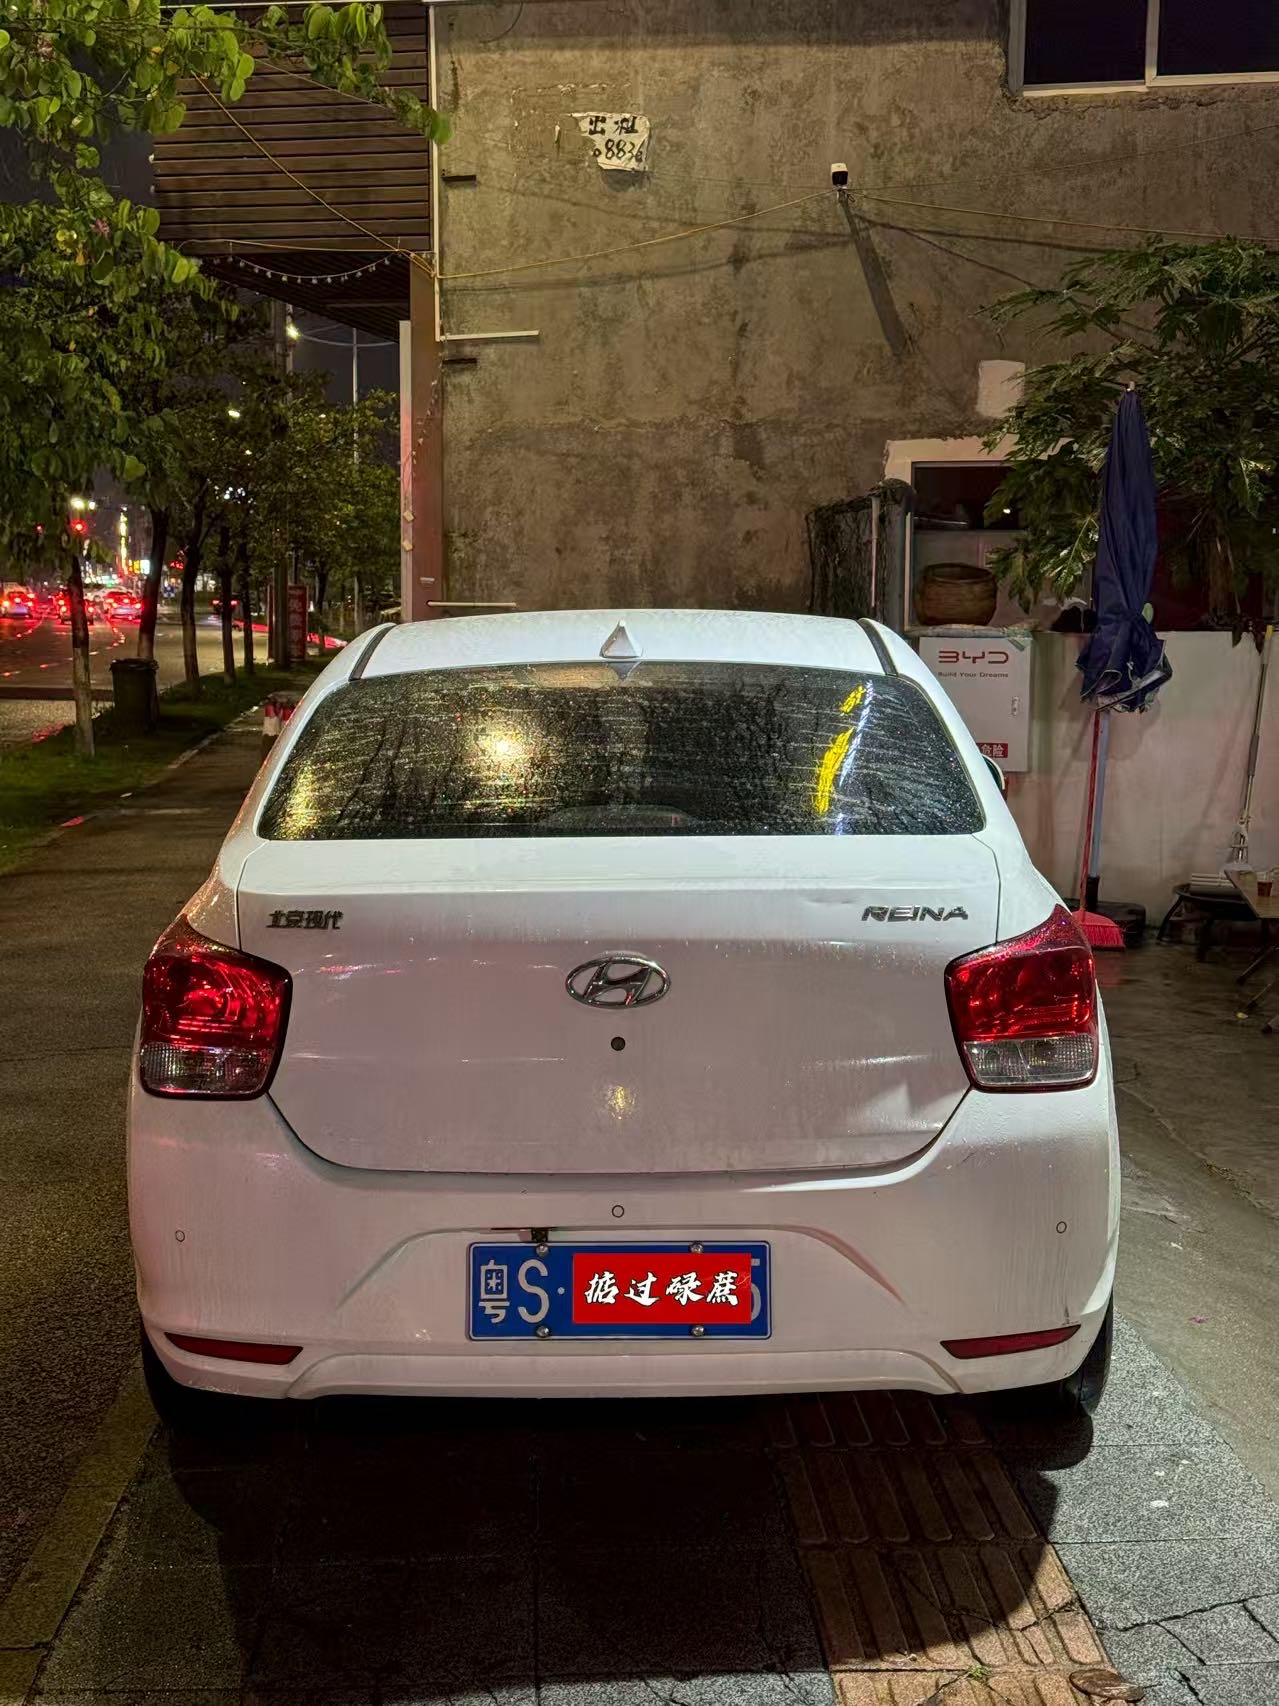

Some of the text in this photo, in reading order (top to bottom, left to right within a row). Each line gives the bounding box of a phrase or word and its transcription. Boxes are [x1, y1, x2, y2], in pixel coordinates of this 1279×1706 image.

[938, 650, 1009, 664] BYD
[266, 910, 344, 930] 北京现代
[861, 905, 969, 921] REINA
